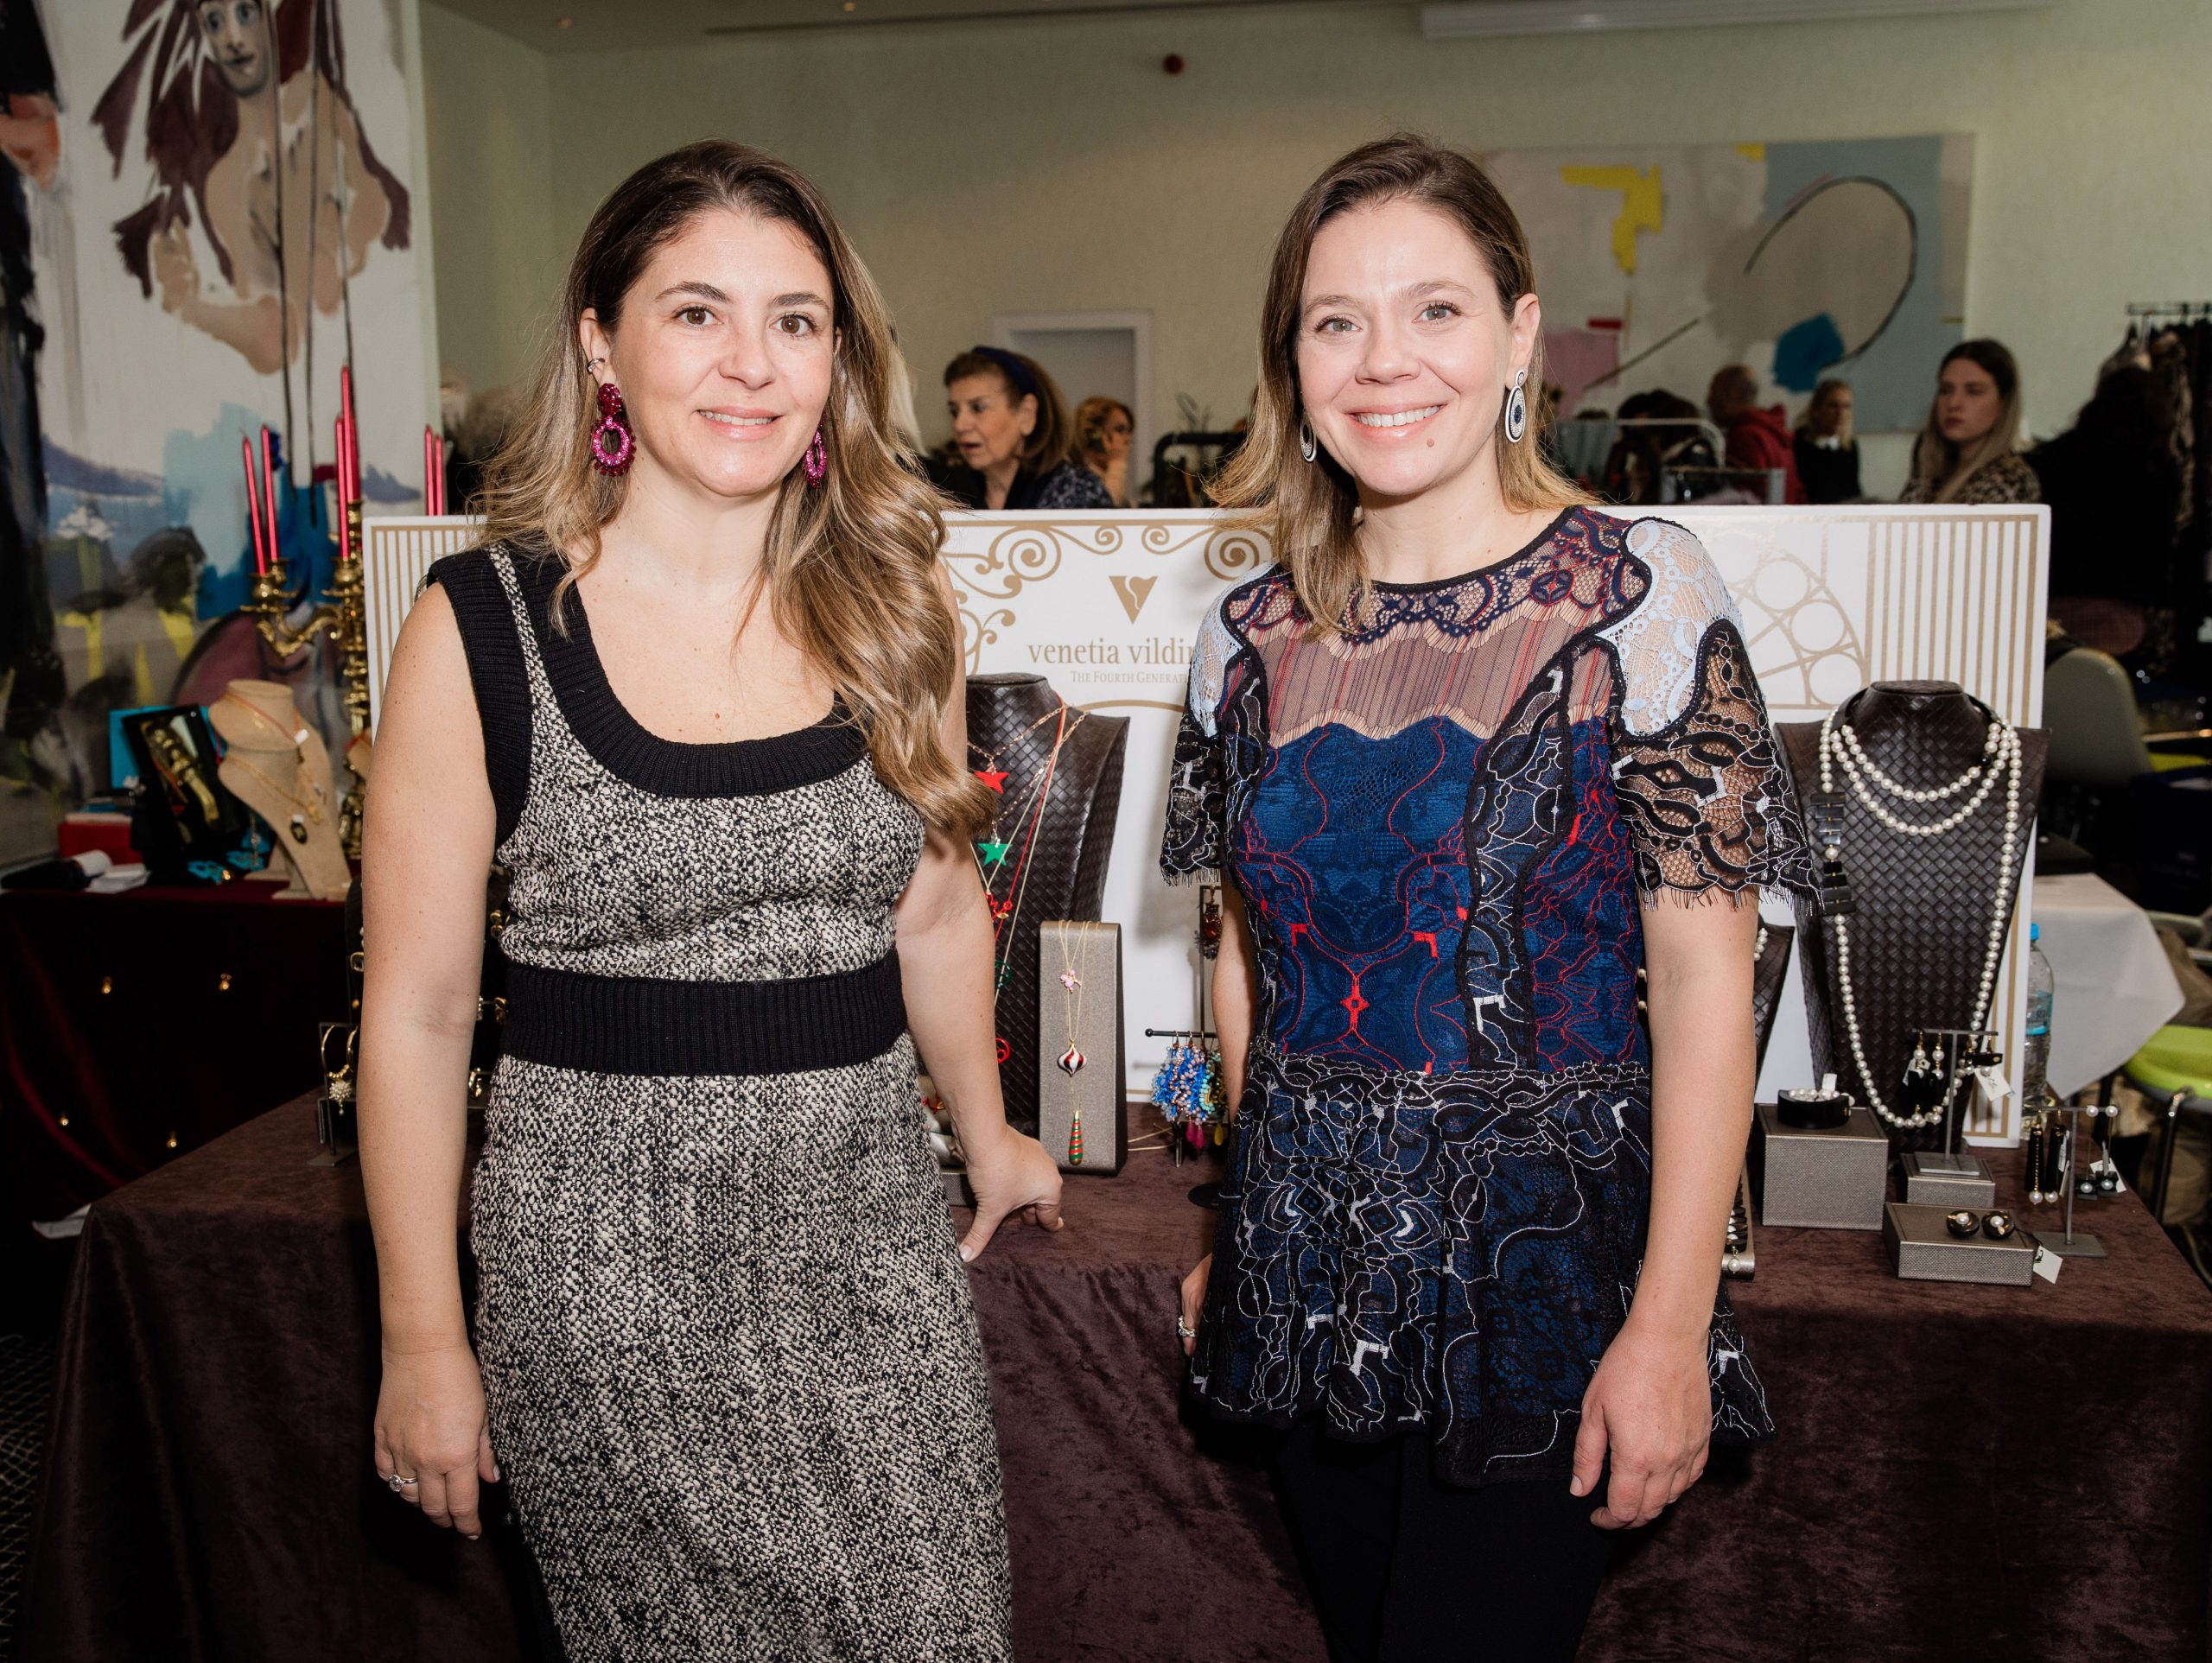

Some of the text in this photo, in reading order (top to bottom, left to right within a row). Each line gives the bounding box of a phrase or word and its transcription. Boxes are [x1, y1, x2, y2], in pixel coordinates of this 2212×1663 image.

[1027, 638, 1120, 664] venetia
[1071, 670, 1090, 683] THE
[1093, 670, 1135, 683] FOURTH
